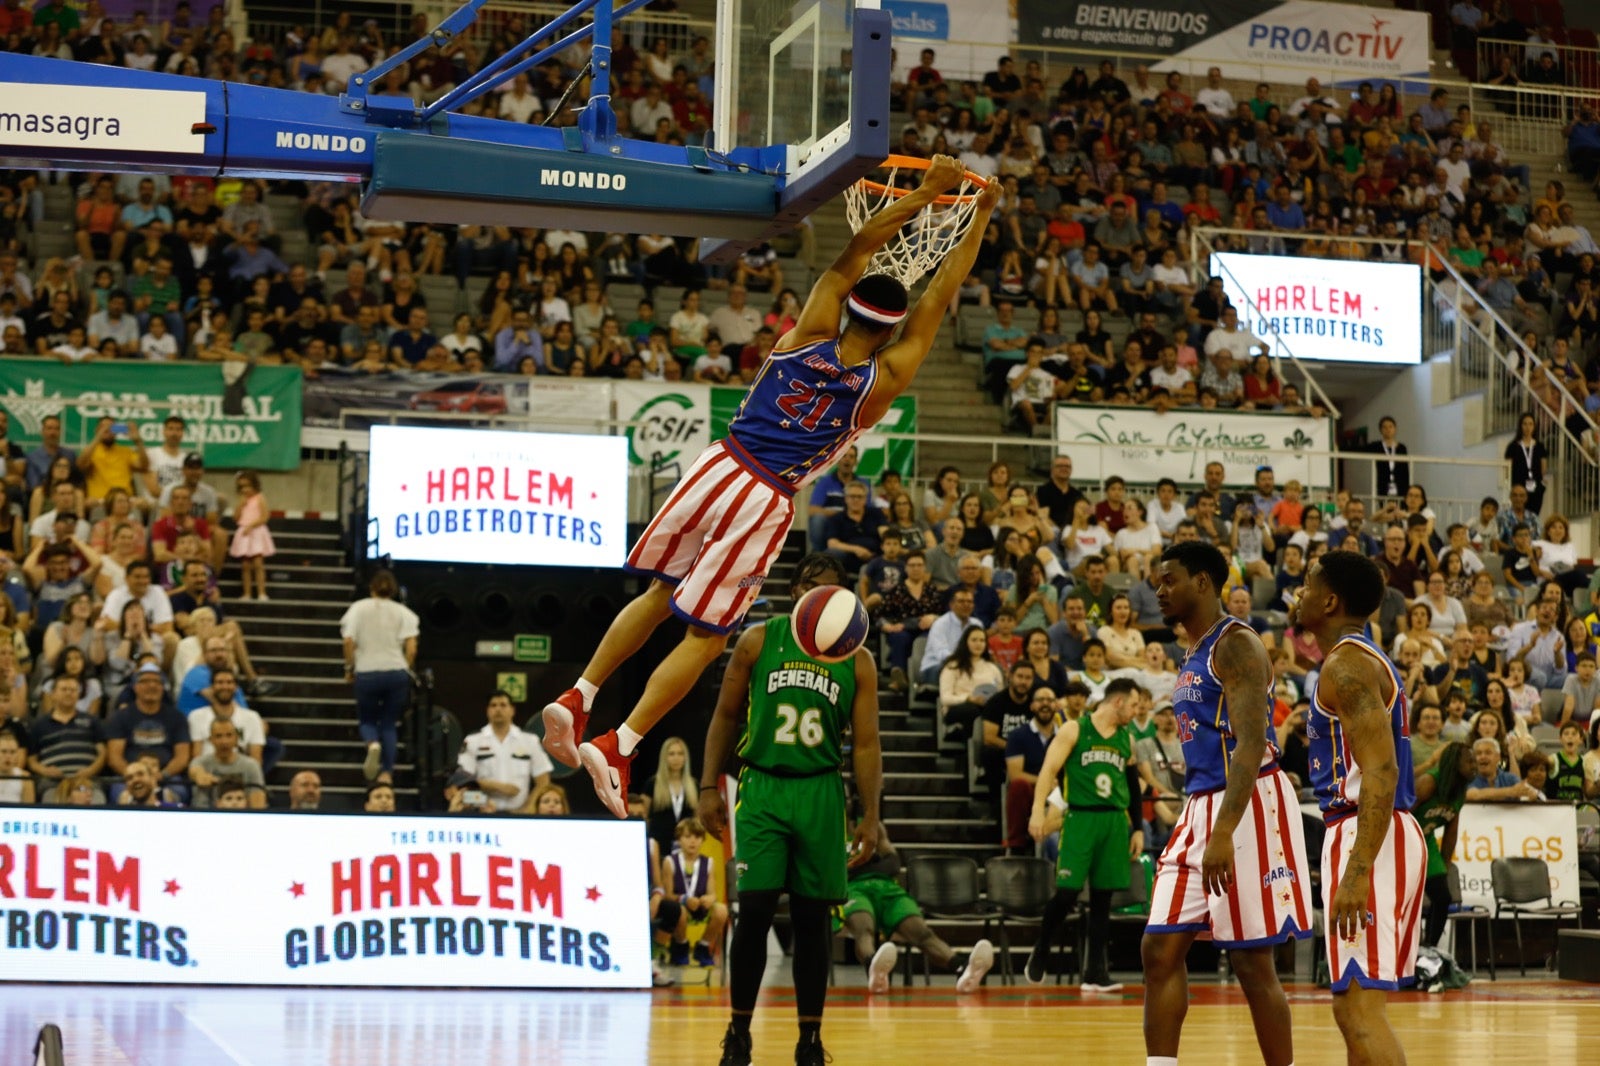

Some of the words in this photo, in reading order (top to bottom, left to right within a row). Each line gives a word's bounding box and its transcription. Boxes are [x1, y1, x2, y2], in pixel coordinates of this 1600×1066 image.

[1076, 4, 1209, 35] BIENVENIDOS
[1157, 34, 1174, 48] de
[1249, 23, 1403, 60] PROACTIV
[0, 112, 120, 141] masagra
[276, 131, 366, 153] MONDO
[540, 169, 627, 191] MONDO
[1257, 285, 1362, 319] HARLEM
[76, 391, 157, 419] CAJA
[775, 378, 835, 432] 21
[640, 416, 704, 442] CSIF
[427, 466, 574, 511] HARLEM
[395, 508, 603, 546] GLOBETROTTERS
[767, 668, 840, 706] GENERALS
[773, 703, 824, 748] 26
[1095, 773, 1113, 799] 9
[3, 821, 80, 838] ORIGINAL
[390, 831, 418, 844] THE
[427, 830, 502, 847] ORIGINAL
[332, 852, 564, 919] HARLEM
[285, 916, 612, 973] GLOBETROTTERS
